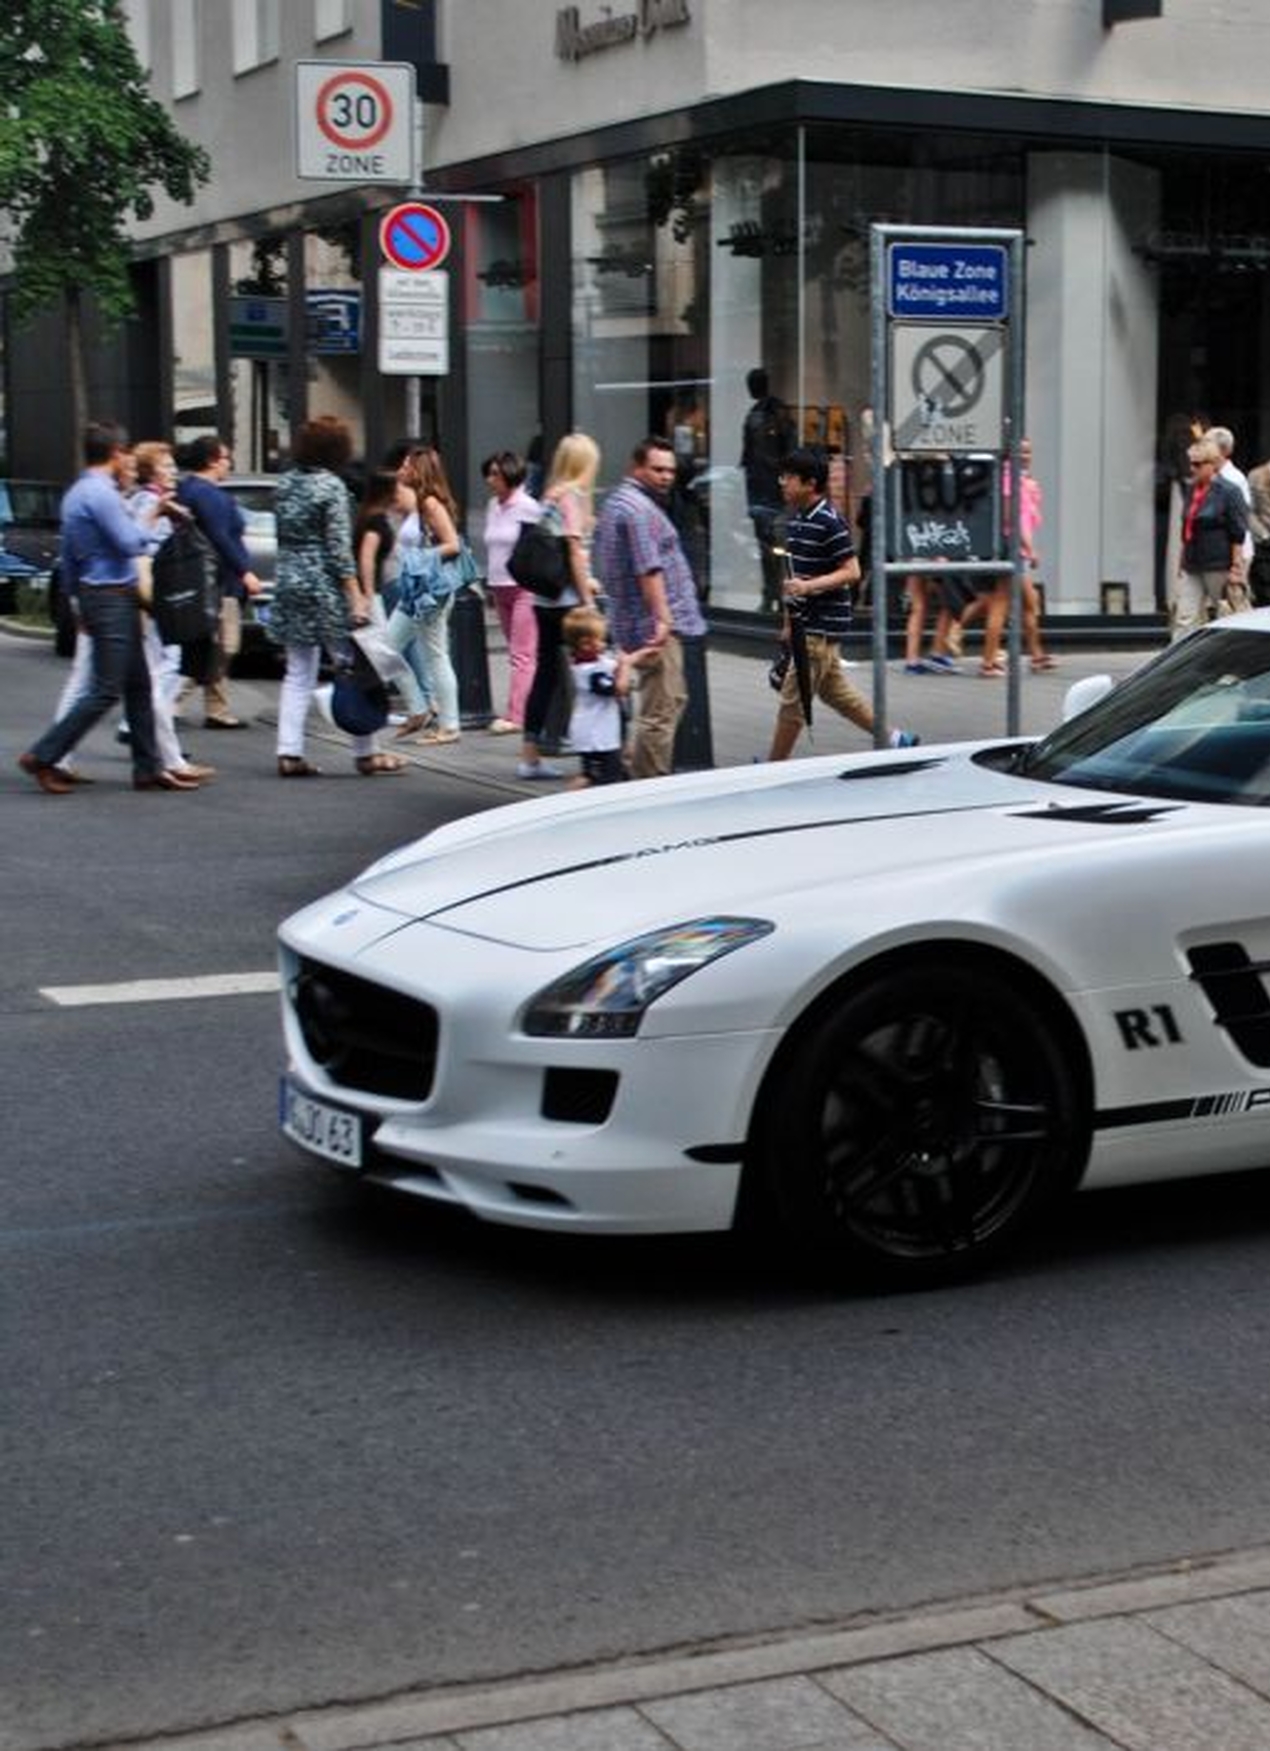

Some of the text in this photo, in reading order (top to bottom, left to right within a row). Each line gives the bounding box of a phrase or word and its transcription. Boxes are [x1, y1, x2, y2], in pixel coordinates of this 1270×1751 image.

[332, 93, 377, 129] 30
[325, 154, 386, 175] ZONE
[897, 259, 997, 281] Blaue Zone
[896, 282, 1000, 307] Königsallee
[918, 424, 976, 445] ZONE
[1113, 1004, 1184, 1051] R1
